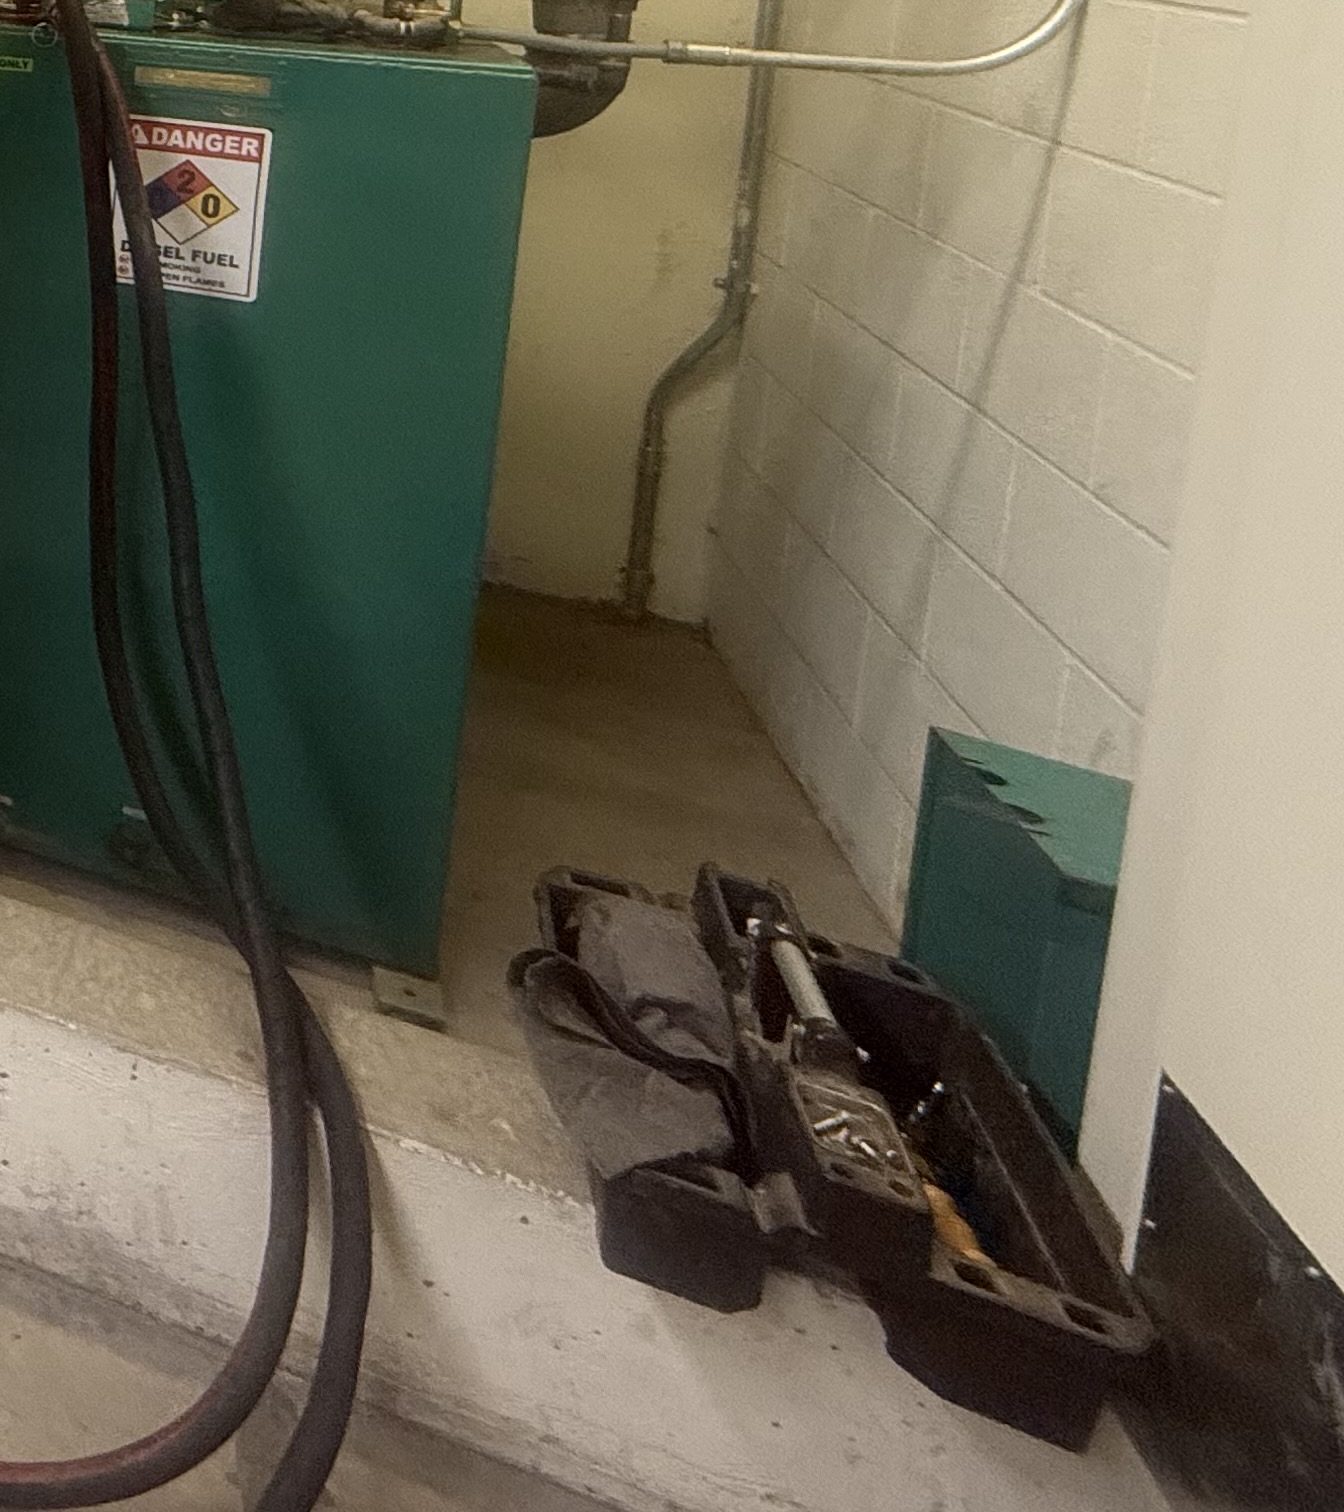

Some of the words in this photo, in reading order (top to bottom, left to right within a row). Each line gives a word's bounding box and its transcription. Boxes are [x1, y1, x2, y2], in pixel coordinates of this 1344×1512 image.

[152, 126, 260, 158] DANGER
[177, 169, 196, 194] 2
[201, 193, 221, 219] 0
[191, 248, 240, 269] FUEL
[182, 275, 225, 288] FLAMES
